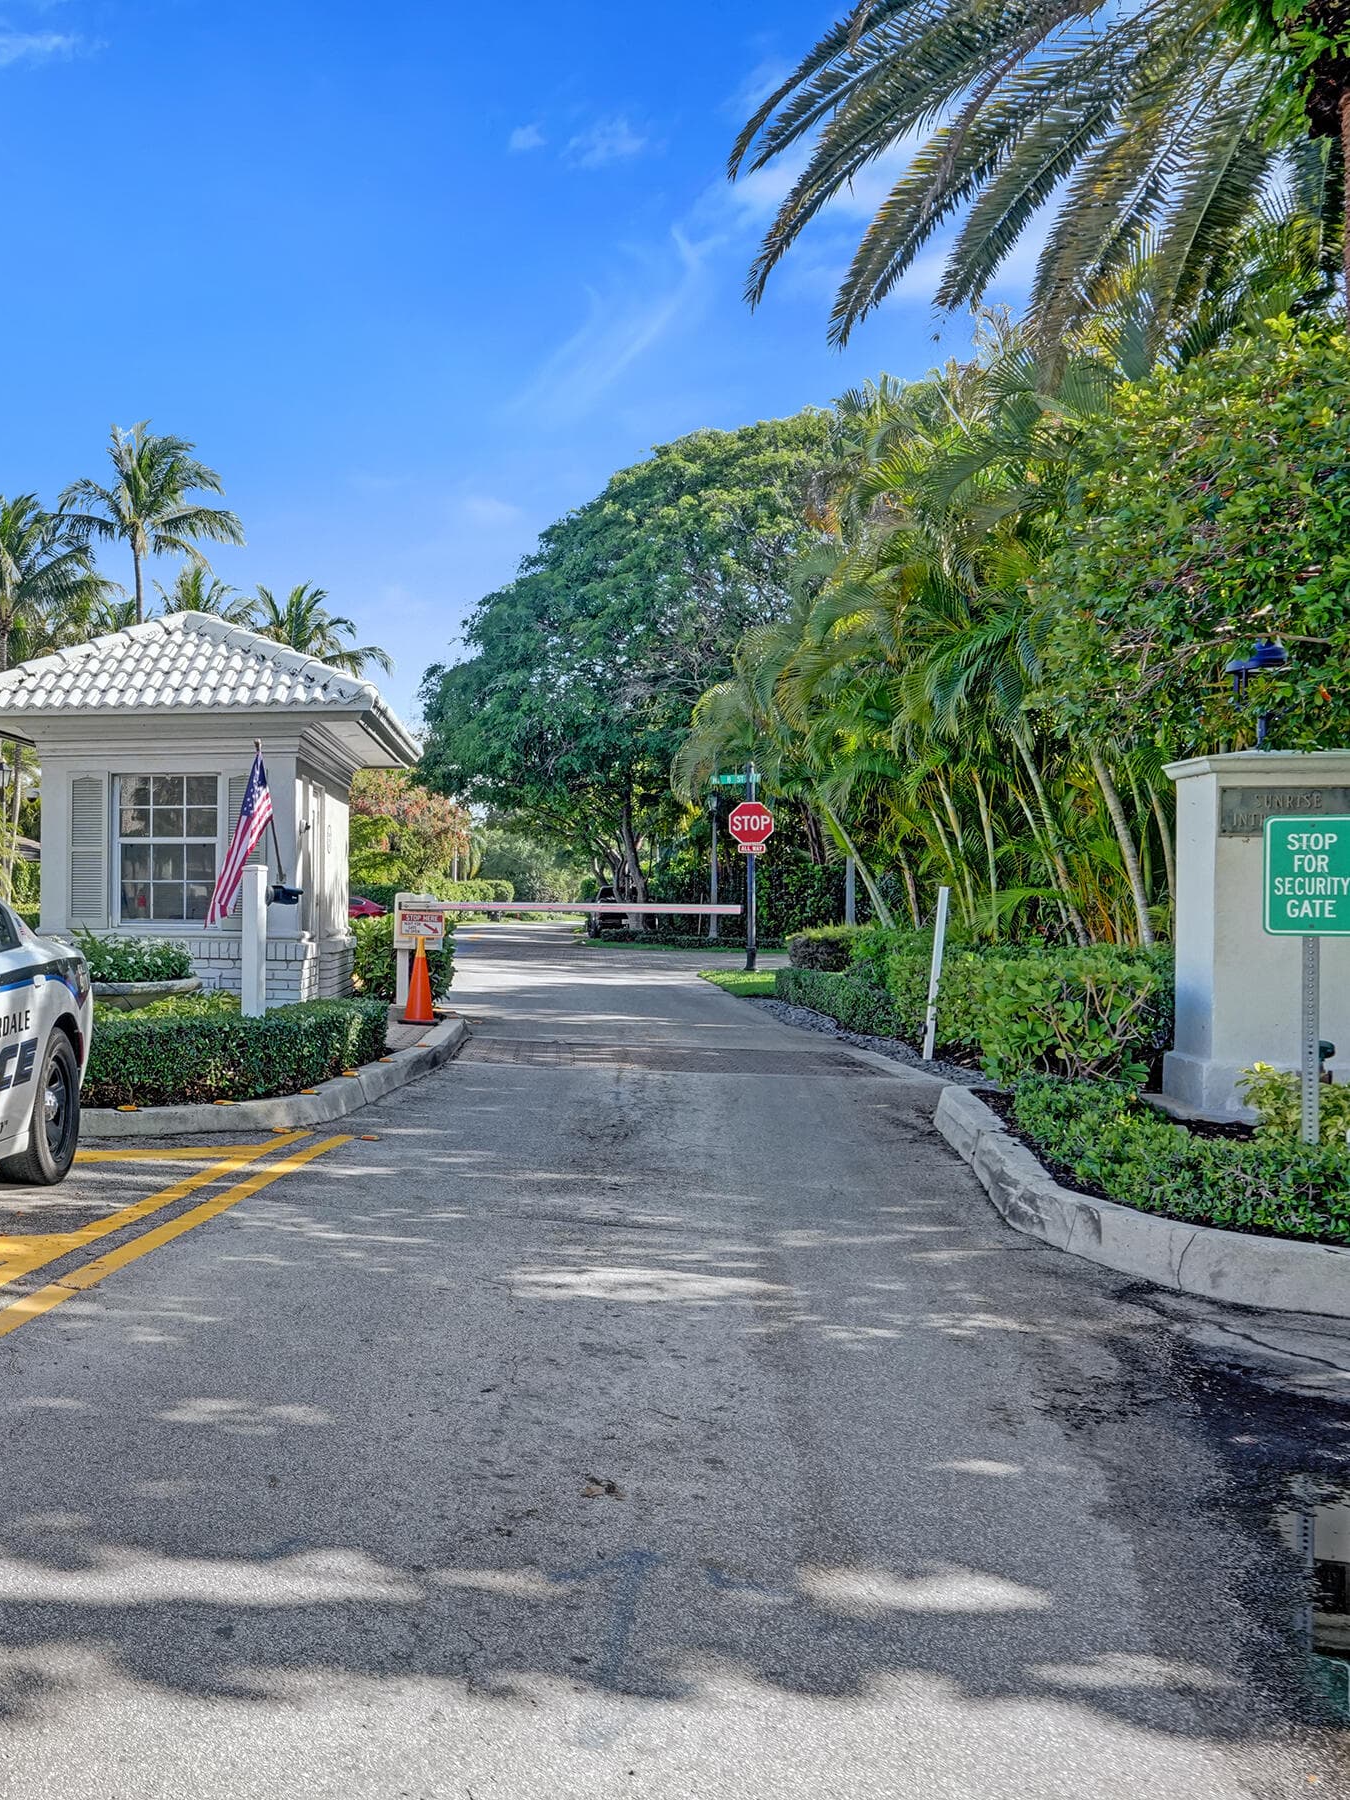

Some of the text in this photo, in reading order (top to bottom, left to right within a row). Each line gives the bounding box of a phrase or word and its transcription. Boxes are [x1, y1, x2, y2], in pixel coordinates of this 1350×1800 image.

[1254, 793, 1323, 809] SUNRISE
[732, 815, 770, 831] STOP
[1286, 833, 1338, 850] STOP
[1293, 854, 1329, 872] FOR
[1273, 877, 1350, 895] SECURITY
[1286, 899, 1337, 918] GATE
